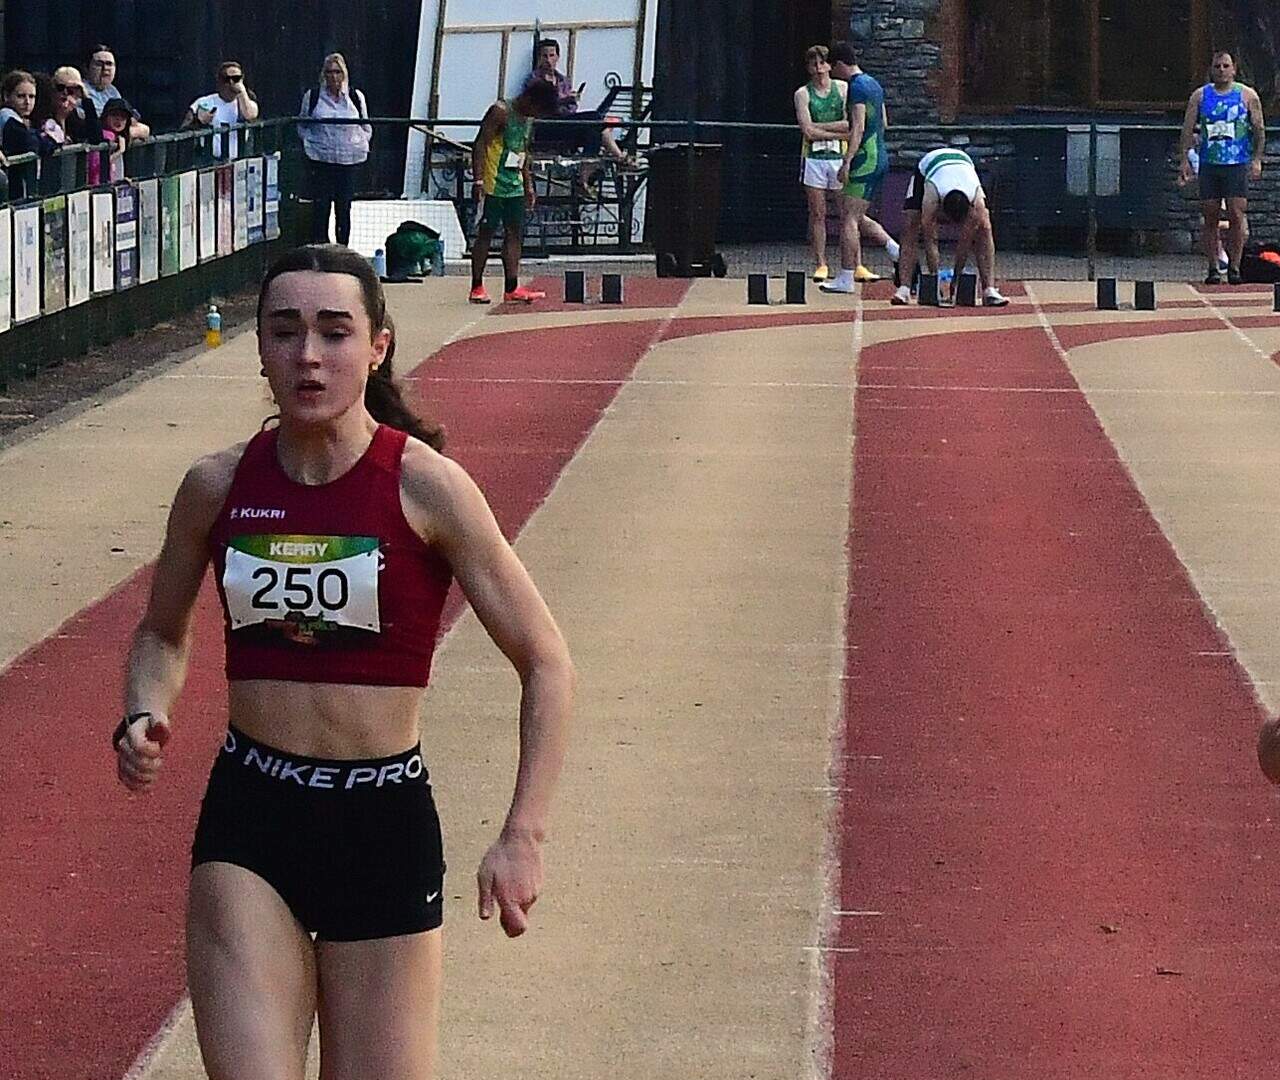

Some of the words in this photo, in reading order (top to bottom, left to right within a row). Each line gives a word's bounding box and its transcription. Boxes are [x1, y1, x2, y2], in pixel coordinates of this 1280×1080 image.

[240, 507, 286, 519] KUKRI
[269, 542, 329, 557] KERRY
[251, 566, 349, 611] 250
[243, 747, 341, 788] NIKE
[344, 754, 423, 789] PRO
